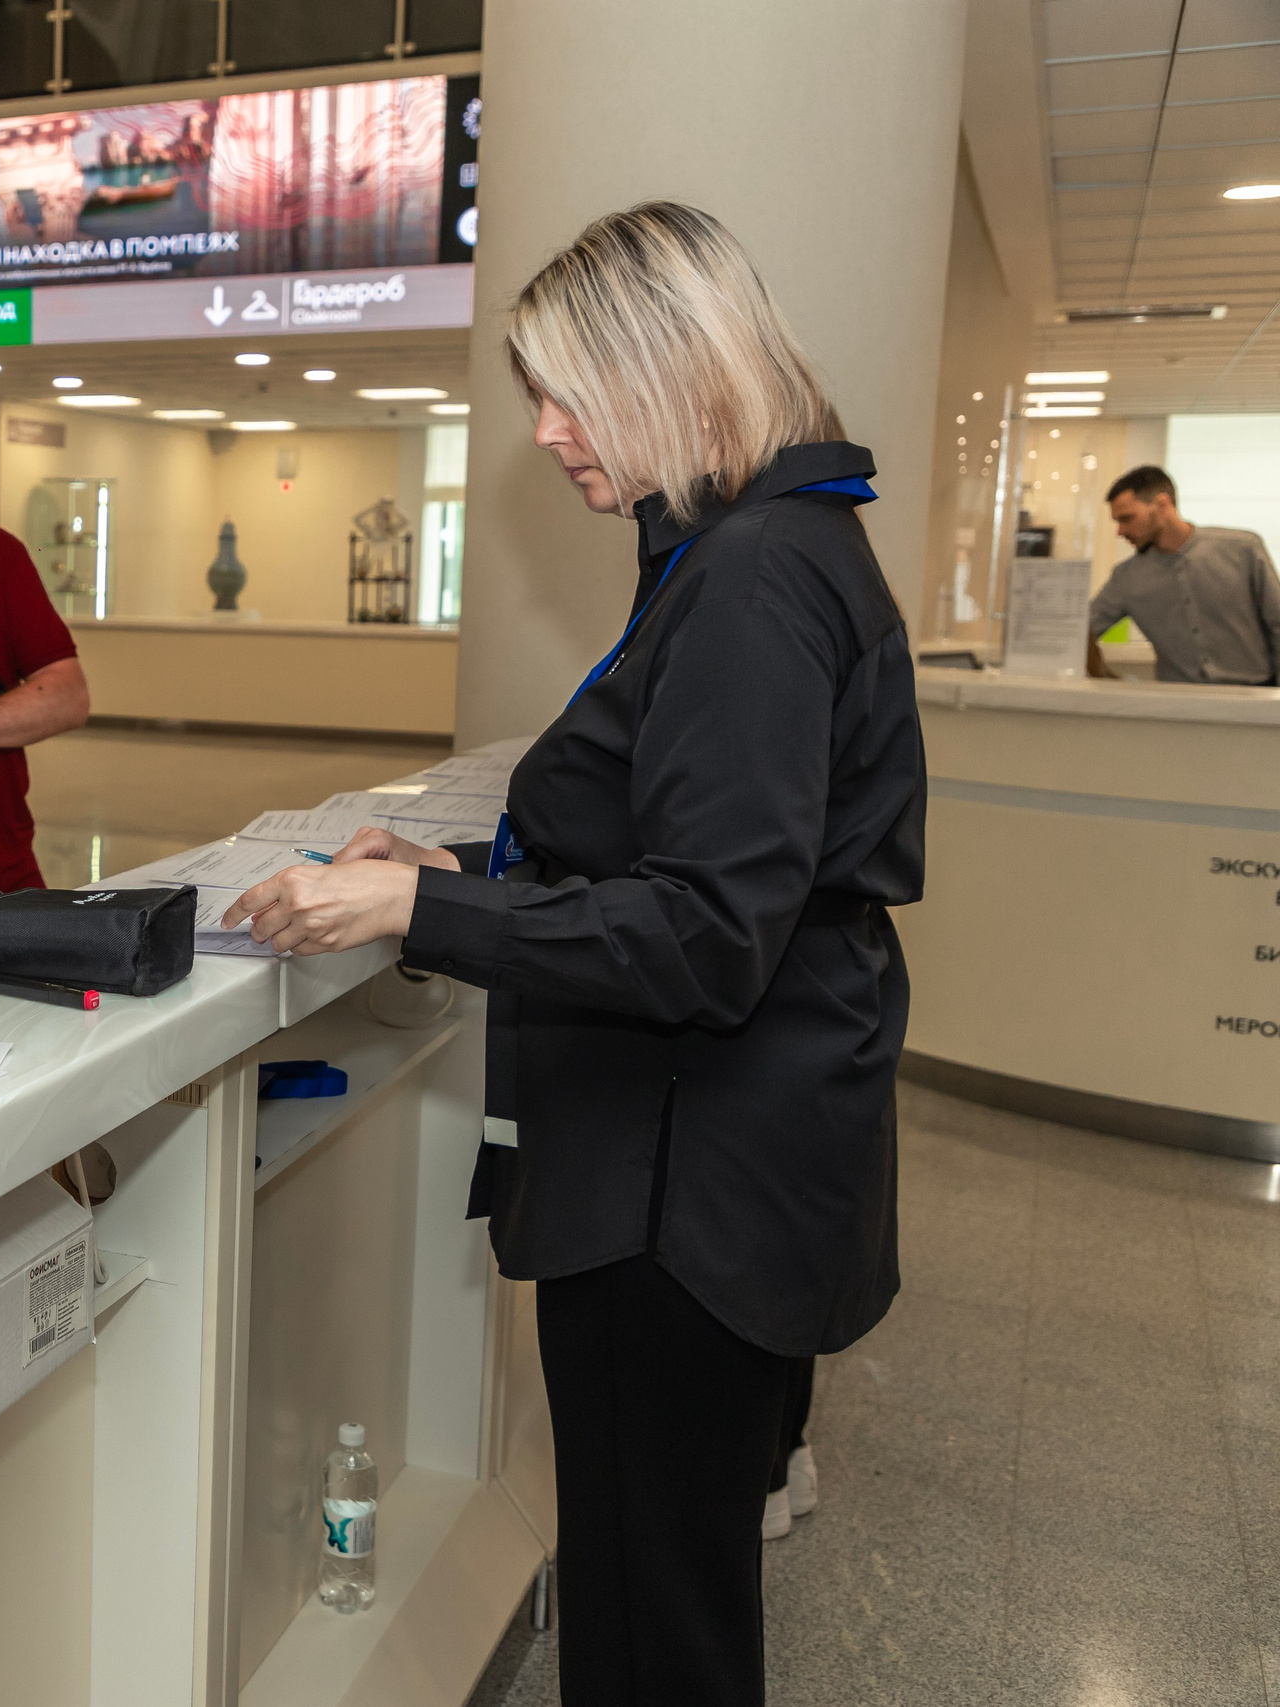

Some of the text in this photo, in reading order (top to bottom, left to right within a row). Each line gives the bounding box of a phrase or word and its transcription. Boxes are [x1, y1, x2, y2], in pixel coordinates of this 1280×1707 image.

[3, 240, 109, 267] НАХОДКА
[109, 238, 124, 259] В
[126, 231, 240, 258] ПОМПЕЯХ
[293, 273, 406, 310] Гардероб
[1216, 1014, 1280, 1039] МЕРО
[30, 1254, 60, 1280] ОФИСМАГ
